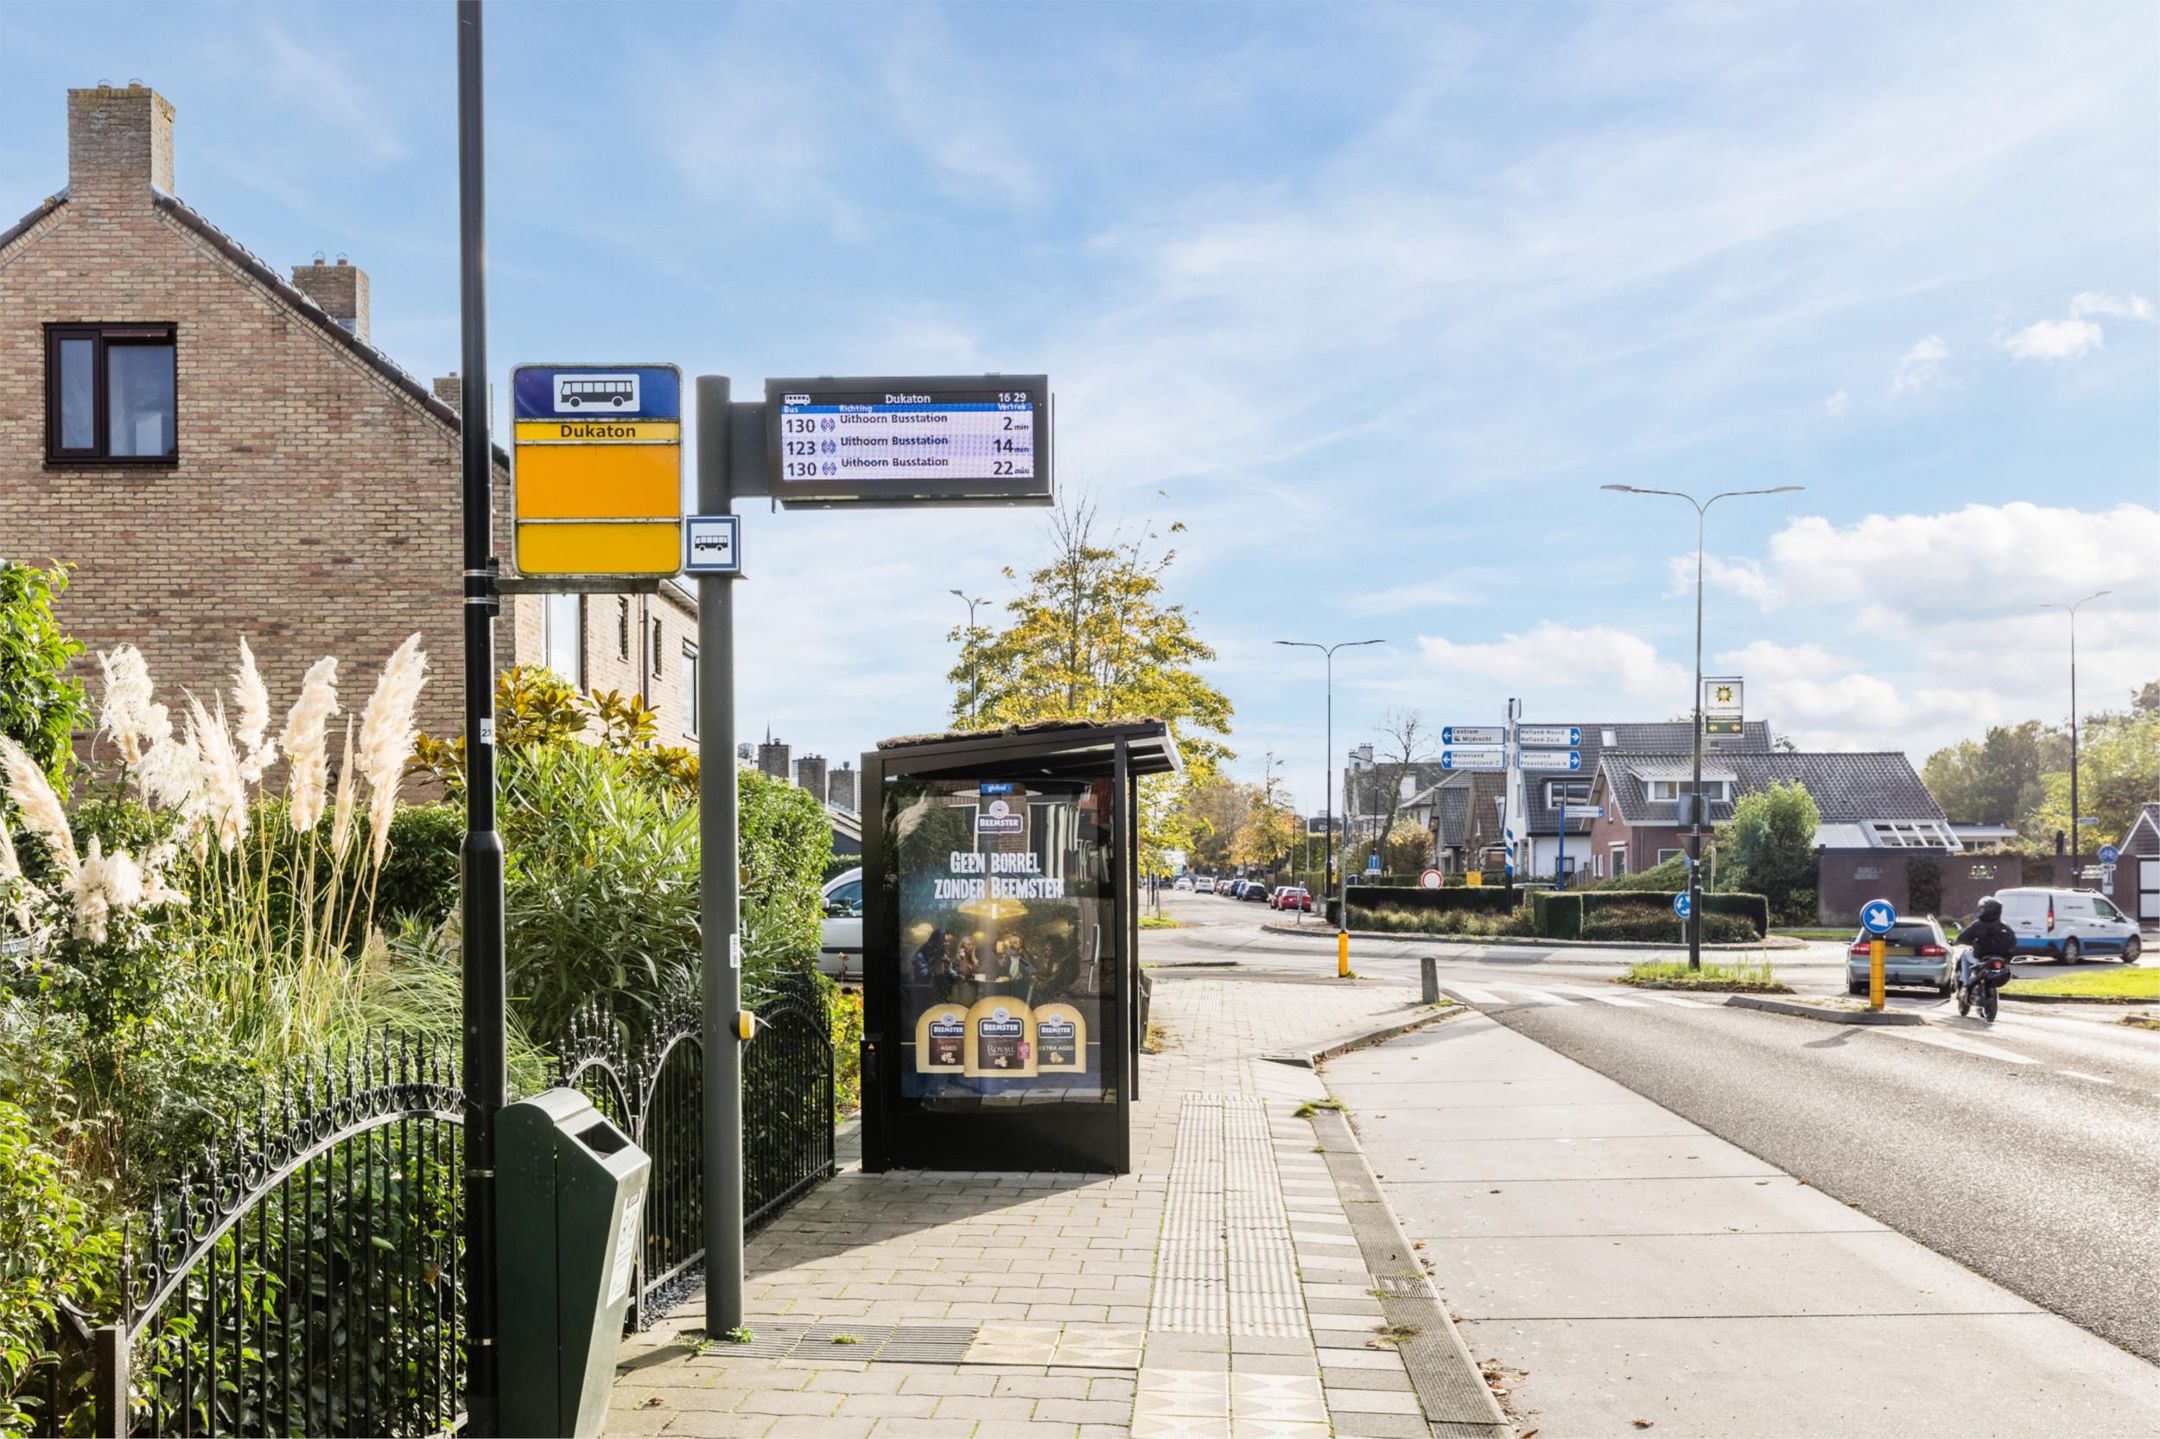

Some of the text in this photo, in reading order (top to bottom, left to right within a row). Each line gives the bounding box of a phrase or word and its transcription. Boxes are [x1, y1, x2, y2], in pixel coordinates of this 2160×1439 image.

[885, 393, 1026, 404] Dukaton 16 29
[783, 405, 798, 413] Bus
[839, 405, 873, 413] Richting
[560, 424, 636, 438] Dukaton
[786, 418, 815, 433] 130
[840, 414, 888, 424] Uithoorn
[891, 414, 948, 424] Busstation
[1003, 416, 1013, 430] 2
[787, 440, 816, 455] 123
[840, 436, 888, 446] Uithoorn
[892, 436, 948, 446] Busstation
[994, 438, 1014, 453] 14
[787, 462, 817, 476] 130
[841, 457, 889, 467] Uithoorn
[893, 457, 949, 467] Busstation
[993, 461, 1013, 475] 22
[979, 819, 1019, 827] BEEMSTER
[950, 851, 1041, 873] GEEN BORREL
[934, 877, 1064, 899] ZONDER BEEMSTER
